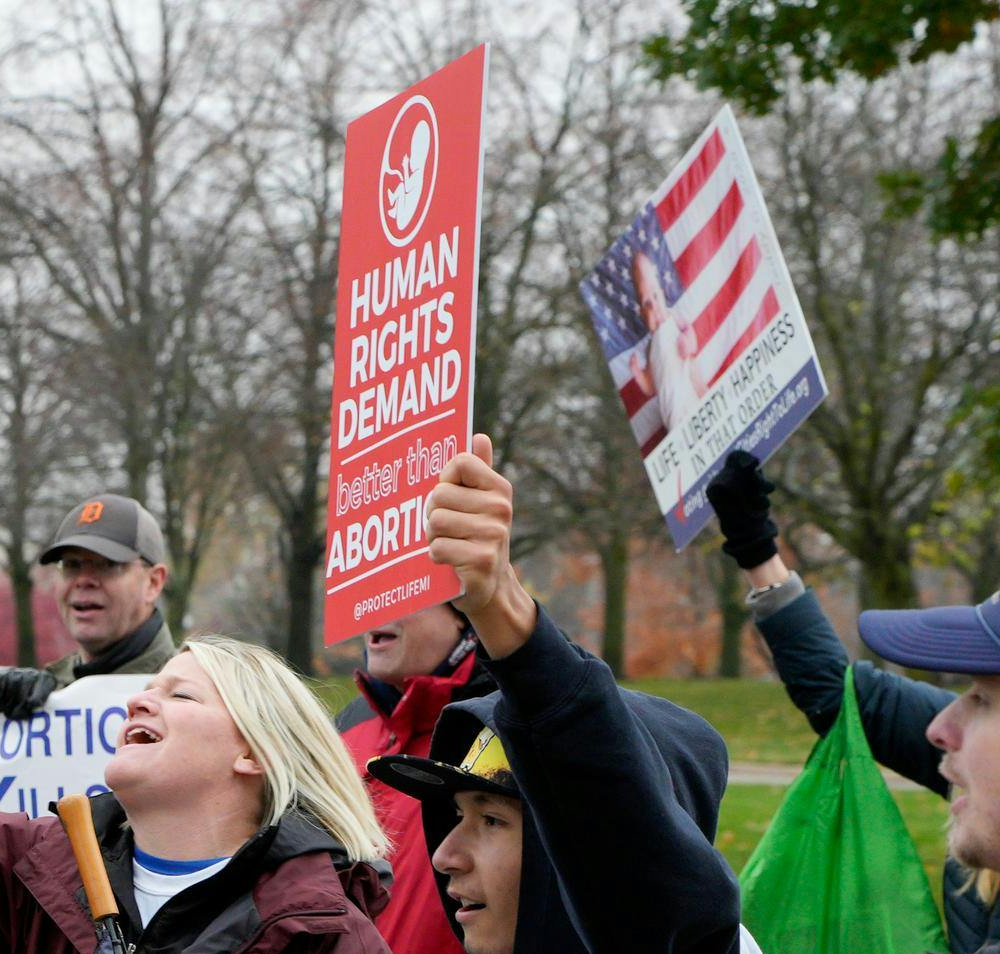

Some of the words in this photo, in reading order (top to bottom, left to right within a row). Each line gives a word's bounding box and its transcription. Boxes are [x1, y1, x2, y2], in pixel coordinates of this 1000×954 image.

[350, 225, 460, 329] HUMAN
[350, 291, 455, 388] RIGHTS
[338, 349, 462, 450] DEMAND
[651, 441, 680, 483] LIFE
[681, 385, 729, 450] LIBERTY
[730, 312, 796, 397] HAPPINESS
[690, 455, 707, 476] IN
[706, 415, 738, 459] THAT
[738, 373, 779, 424] ORDER
[336, 458, 402, 517] better
[406, 434, 457, 486] than
[326, 490, 435, 579] ABORTI
[353, 575, 431, 620] @PROTECTLIFEMI
